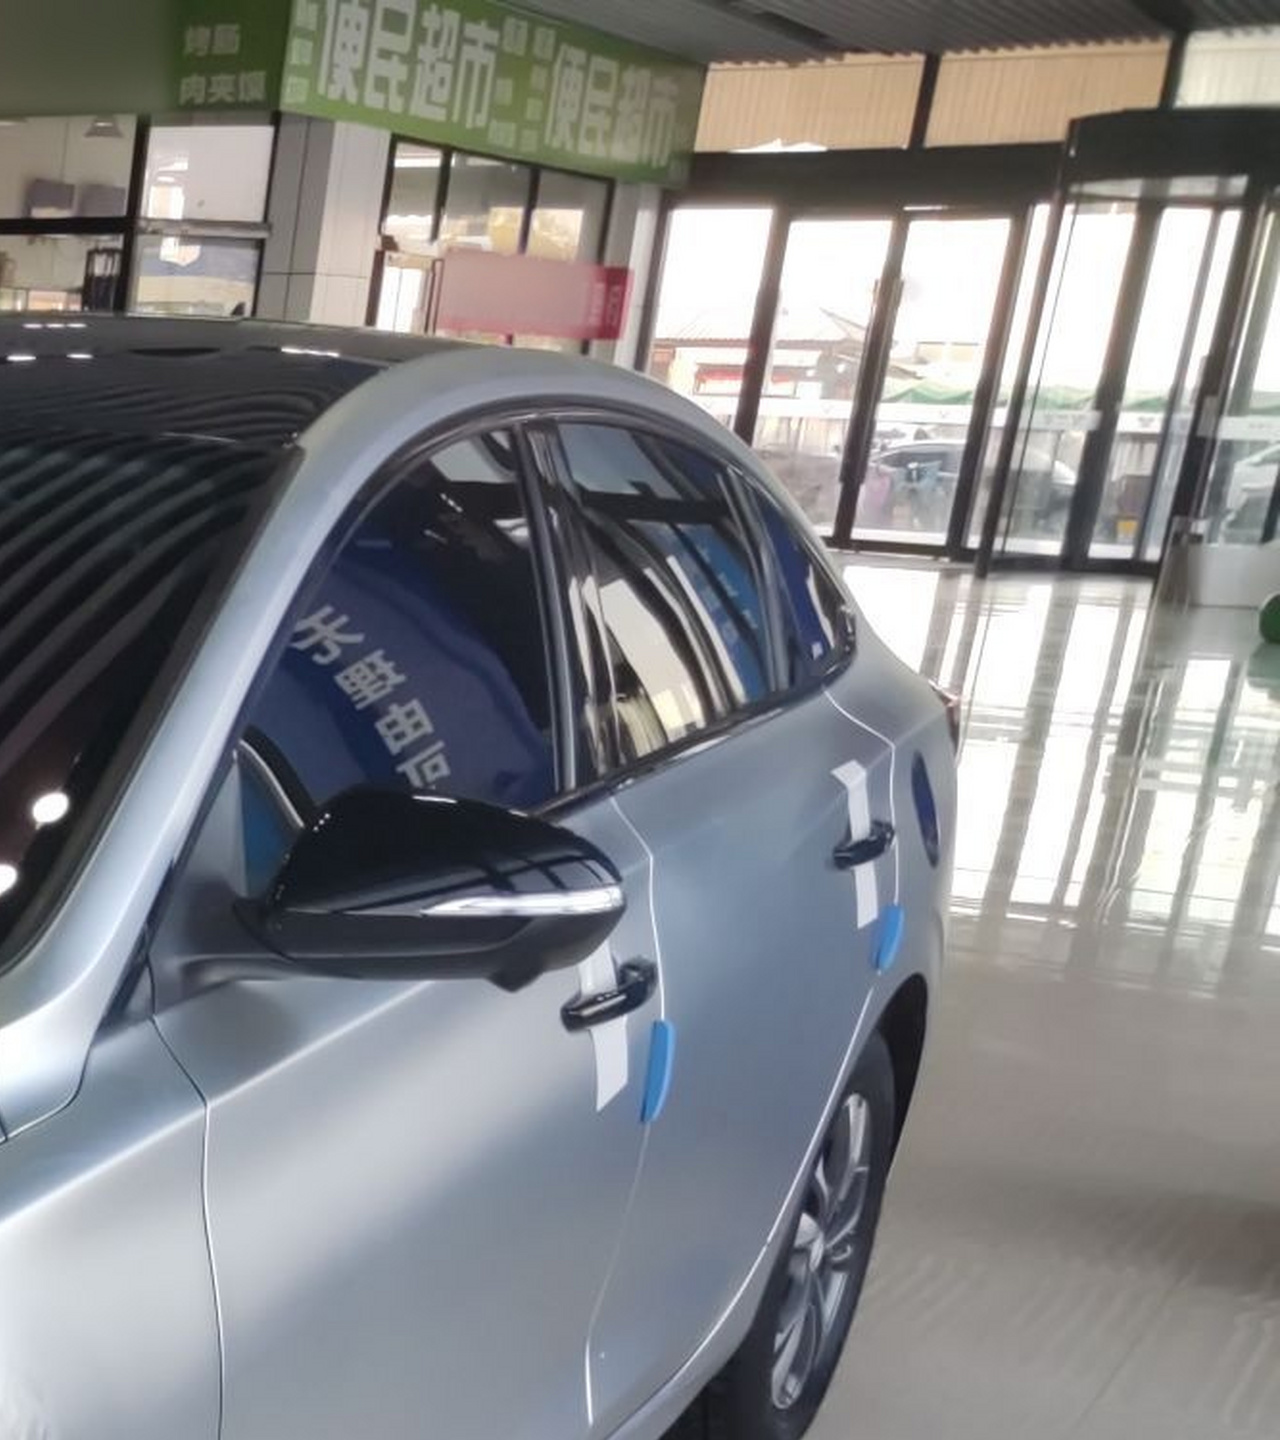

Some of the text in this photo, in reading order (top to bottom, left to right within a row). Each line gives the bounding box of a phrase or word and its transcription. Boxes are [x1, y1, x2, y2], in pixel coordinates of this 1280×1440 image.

[317, 0, 501, 130] 便民超市
[545, 42, 681, 169] 便民超市
